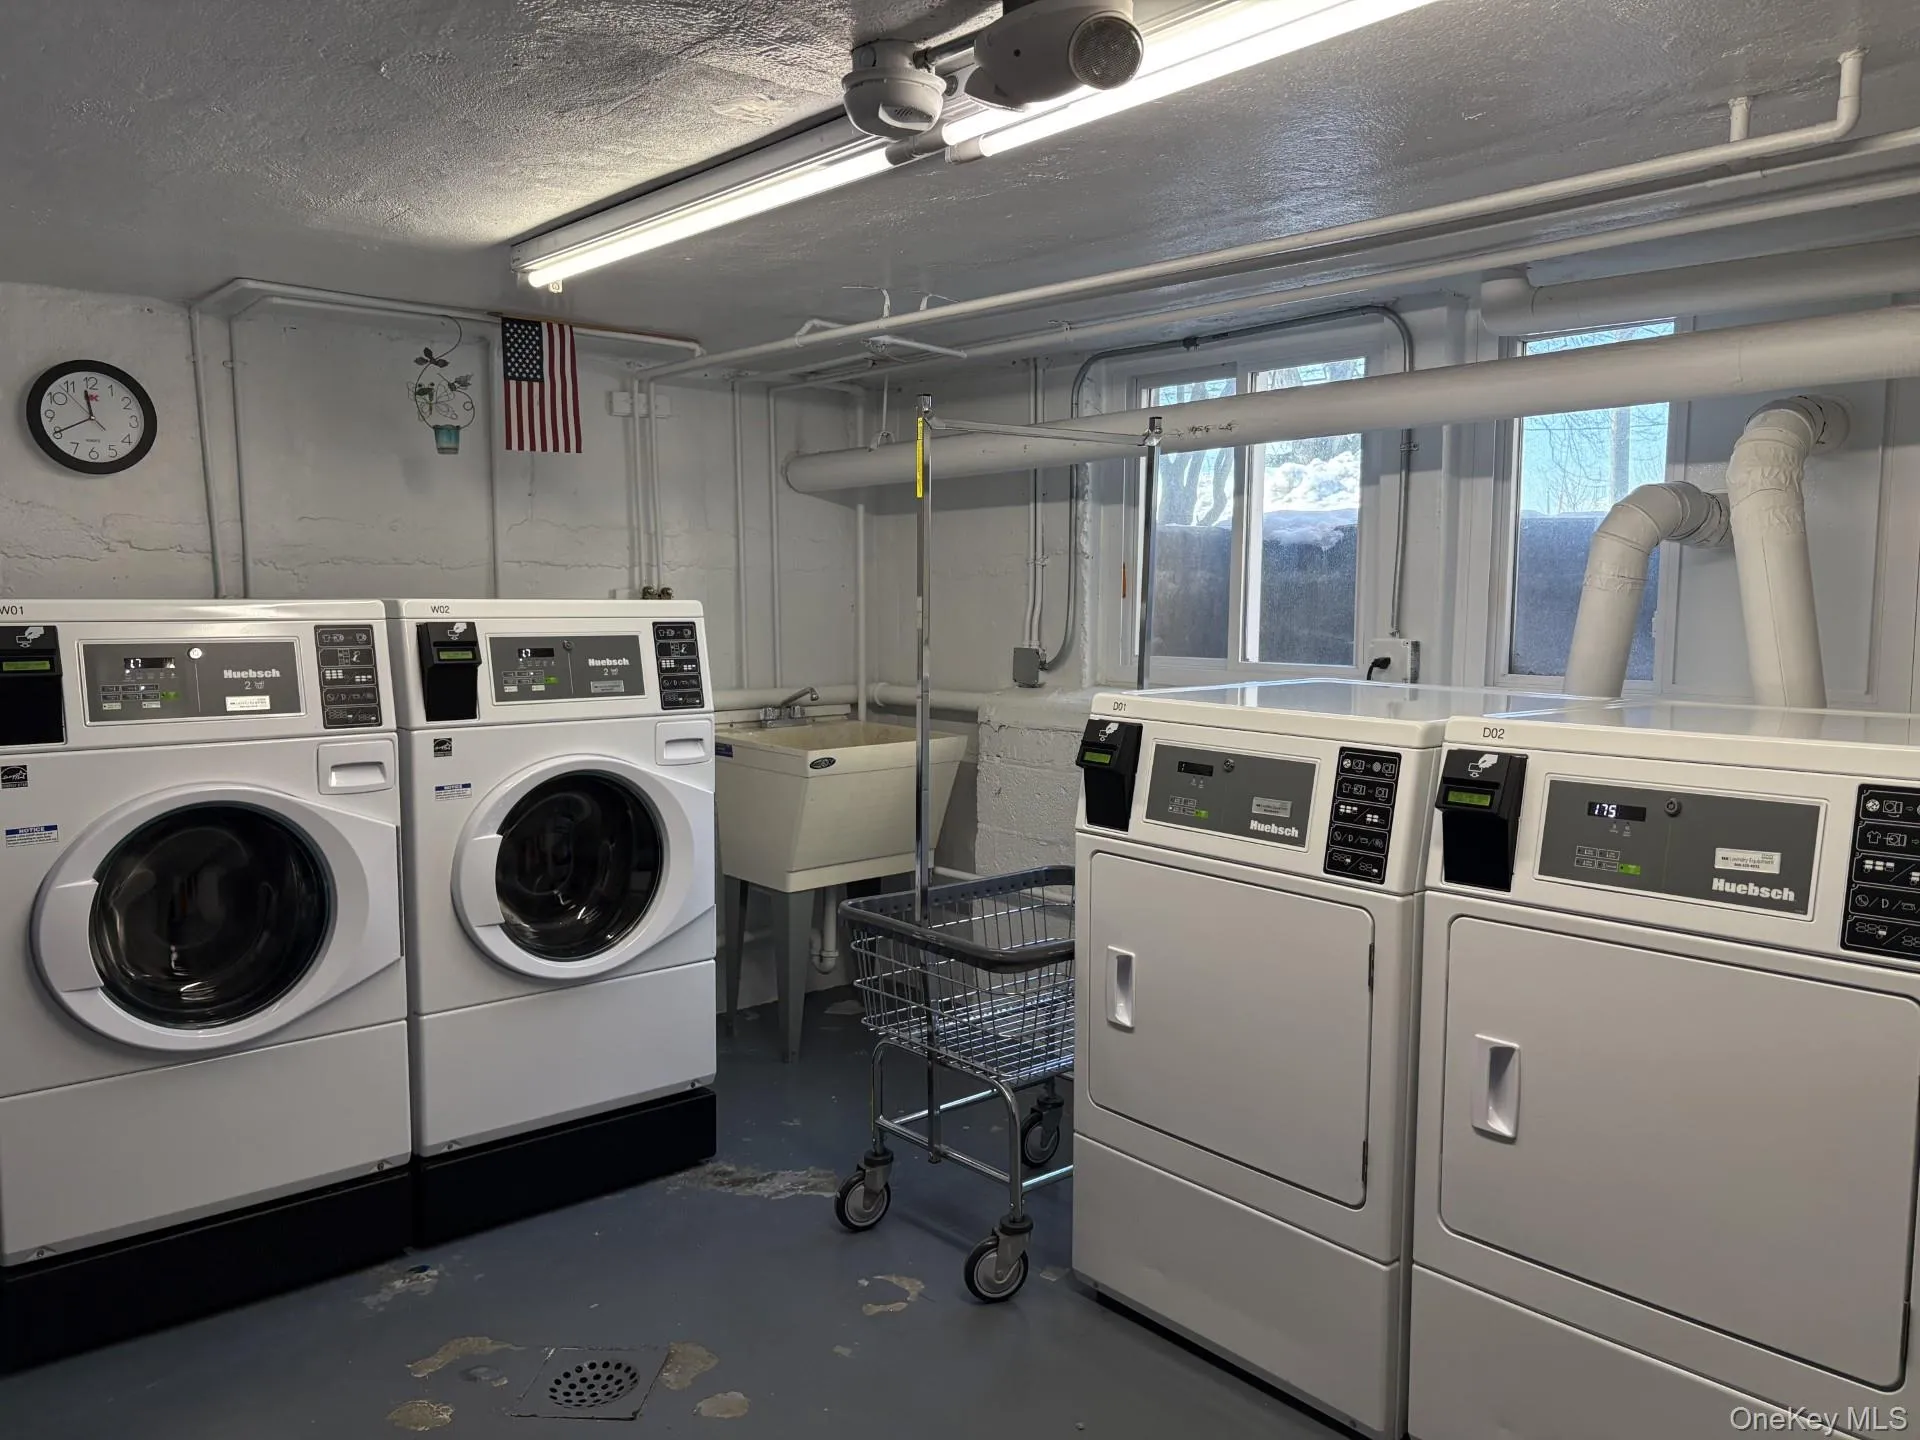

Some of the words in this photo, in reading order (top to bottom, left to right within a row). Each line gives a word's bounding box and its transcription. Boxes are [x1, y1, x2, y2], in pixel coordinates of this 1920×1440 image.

[64, 380, 75, 393] 11
[83, 376, 99, 390] 12
[107, 384, 114, 397] 1
[47, 391, 68, 406] 10
[121, 396, 132, 410] 2
[44, 409, 56, 423] 9
[128, 415, 139, 429] 3
[52, 426, 63, 440] 8
[121, 433, 133, 446] 4
[70, 442, 80, 455] 7
[88, 447, 100, 460] 6
[108, 444, 118, 458] 5
[431, 605, 450, 614] W02
[588, 657, 631, 667] Huebsch
[223, 668, 281, 679] Huebsch
[603, 667, 609, 676] 2
[244, 681, 252, 690] 2
[1113, 701, 1126, 712] D01
[1482, 727, 1505, 739] D02
[1594, 803, 1617, 818] 175
[1250, 819, 1299, 838] Huebsch
[1712, 877, 1796, 902] Huebsch
